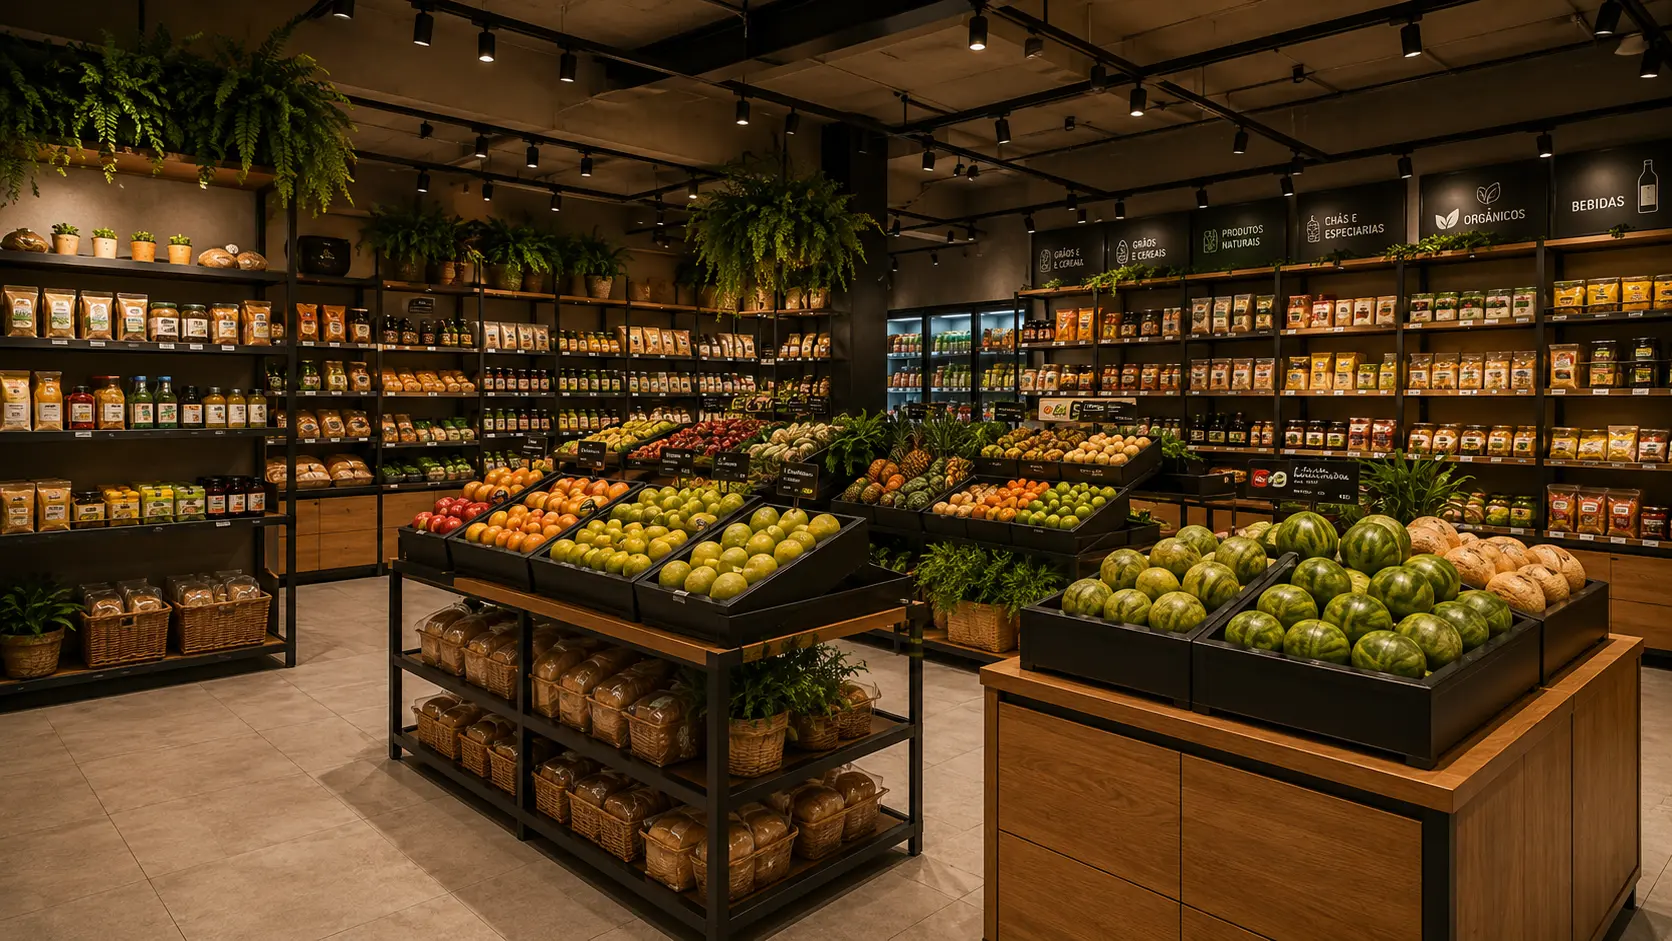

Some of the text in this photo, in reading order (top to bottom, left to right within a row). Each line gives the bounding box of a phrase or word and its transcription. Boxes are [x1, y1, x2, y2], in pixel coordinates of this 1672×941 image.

[1572, 195, 1625, 212] BEBIDAS
[1324, 212, 1358, 226] CHÁS E
[1222, 224, 1264, 238] PRODUTOS
[1324, 223, 1385, 240] ESPECIARIAS
[1222, 236, 1261, 250] NATURAIS
[1131, 248, 1166, 261] E CEREAIS
